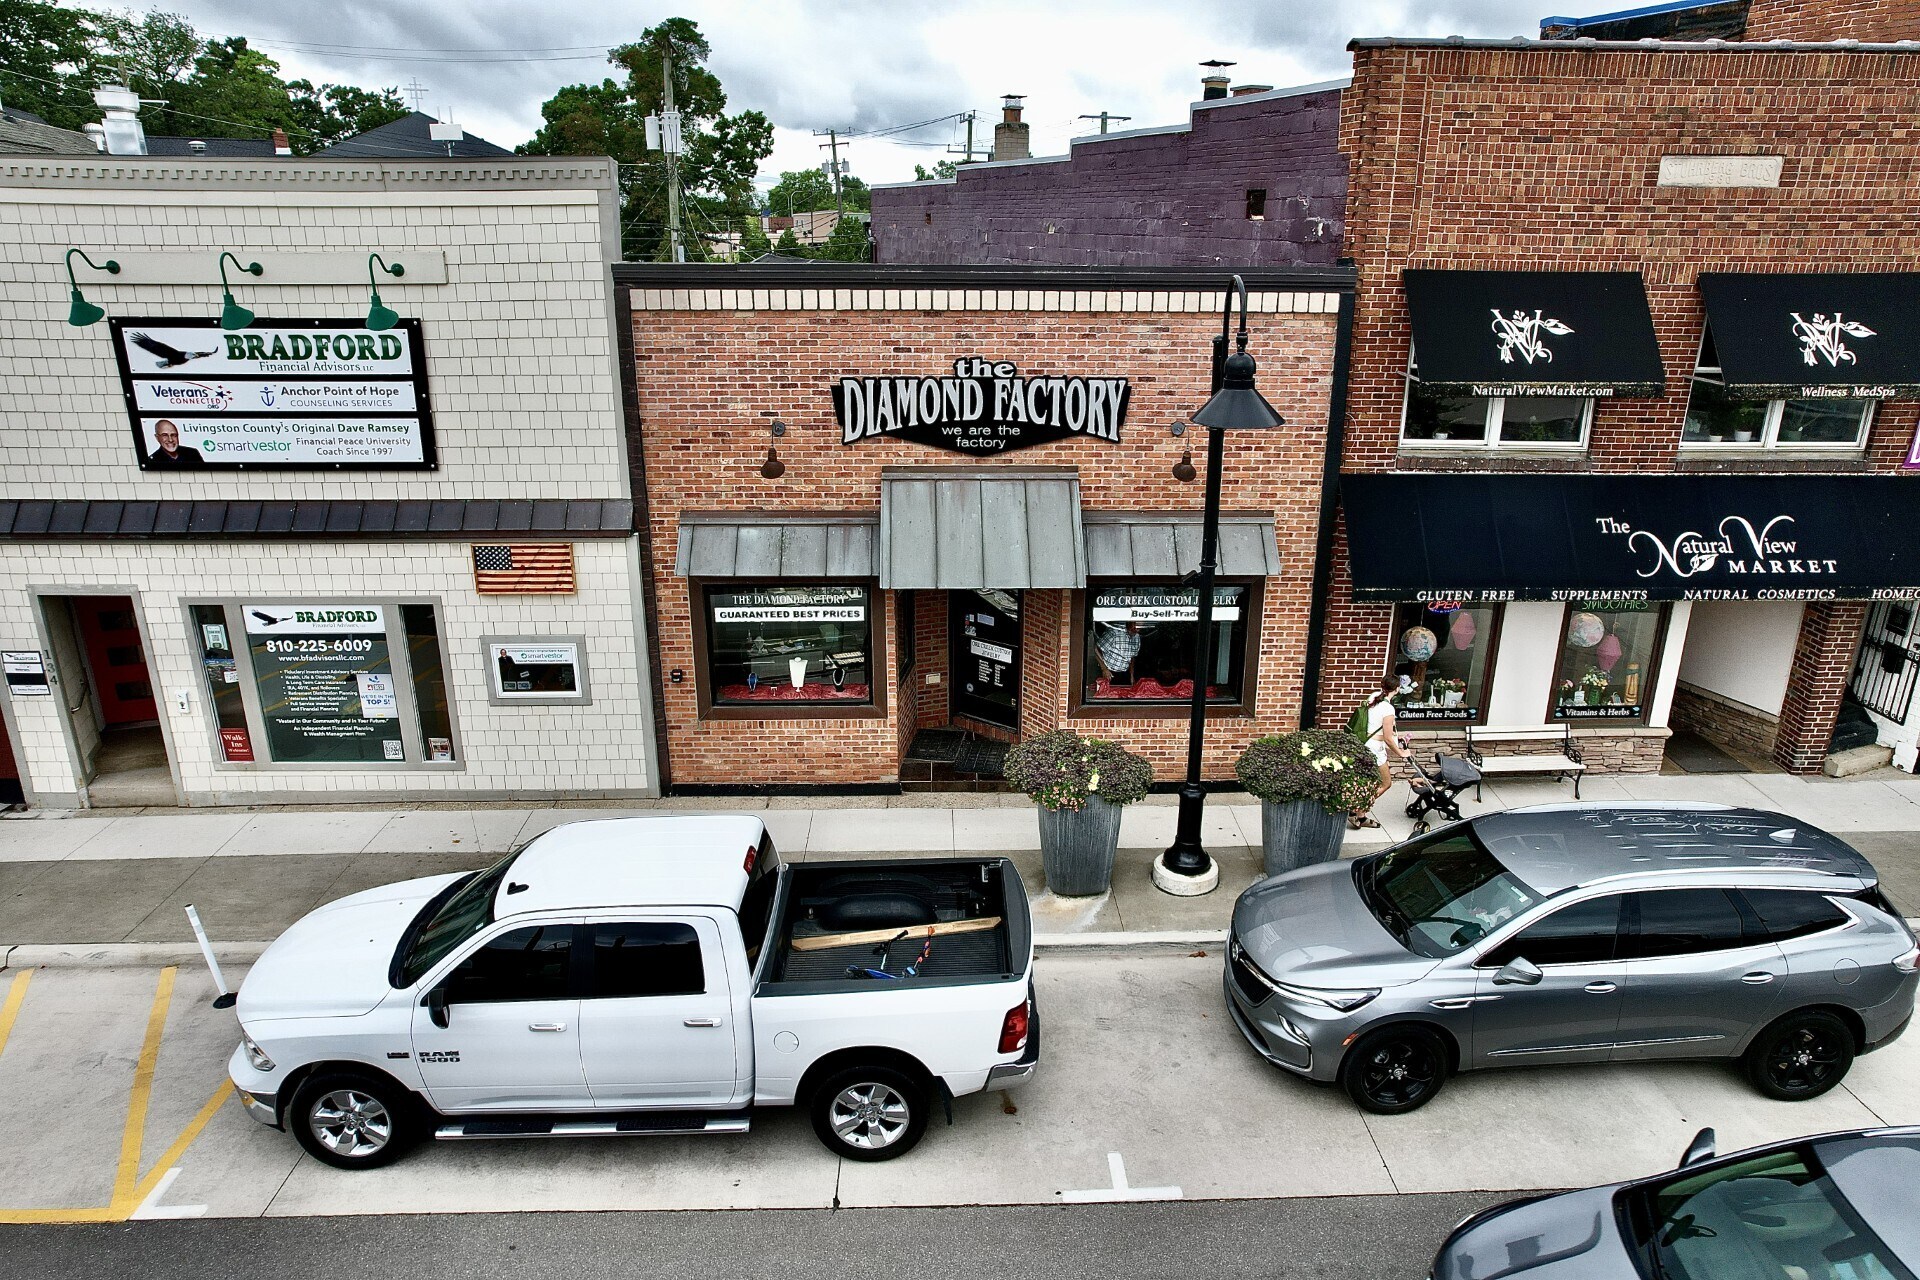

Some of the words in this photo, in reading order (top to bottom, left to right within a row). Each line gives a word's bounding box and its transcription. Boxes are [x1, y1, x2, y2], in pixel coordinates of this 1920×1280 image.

[223, 334, 403, 361] BRADFORD
[259, 361, 310, 373] Financial
[313, 361, 360, 372] Advisors
[955, 358, 1015, 378] the
[151, 384, 209, 398] Veterans
[281, 386, 321, 396] Anchor
[324, 386, 353, 396] Point
[355, 386, 368, 396] of
[370, 386, 399, 398] Hope
[1472, 384, 1614, 396] NaturalViewMarket.com
[1802, 386, 1848, 397] Wellness
[1852, 386, 1896, 398] MedSpa
[170, 397, 221, 405] CONNECTED
[842, 378, 984, 444] DIAMOND
[993, 378, 1127, 442] FACTORY
[182, 424, 240, 435] Livingston
[242, 423, 290, 435] County's
[292, 423, 335, 435] Original
[338, 424, 365, 433] Dave
[368, 424, 410, 435] Ramsey
[998, 426, 1020, 436] the
[216, 441, 292, 452] smartvestor
[296, 438, 336, 446] Financial
[338, 438, 364, 446] Peace
[366, 438, 411, 447] University
[956, 437, 1006, 449] factory
[316, 447, 344, 456] Coach
[346, 447, 370, 456] Since
[372, 447, 393, 456] 1997
[1596, 518, 1630, 534] The
[1628, 531, 1734, 577] Natural
[1719, 516, 1796, 559] View
[1728, 560, 1837, 574] MARKET
[732, 596, 752, 604] THE
[754, 595, 800, 604] DIAMOND
[800, 594, 846, 604] FACTORY
[1416, 590, 1473, 600] GLUTEN
[1482, 590, 1515, 600] FREE
[1551, 590, 1648, 600] SUPPLEMENTS
[1684, 590, 1749, 600] NATURAL
[1757, 589, 1836, 600] COSMETICS
[1096, 596, 1116, 606] ORE
[1118, 596, 1150, 606] CREEK
[1152, 596, 1192, 606] CUSTOM
[1193, 596, 1238, 606] JELRY
[1427, 600, 1462, 610] OPEN
[295, 610, 378, 623] BRADFORD
[822, 610, 860, 618] PRICES
[266, 640, 372, 652] 810-225-6009
[1399, 710, 1424, 718] Gluten
